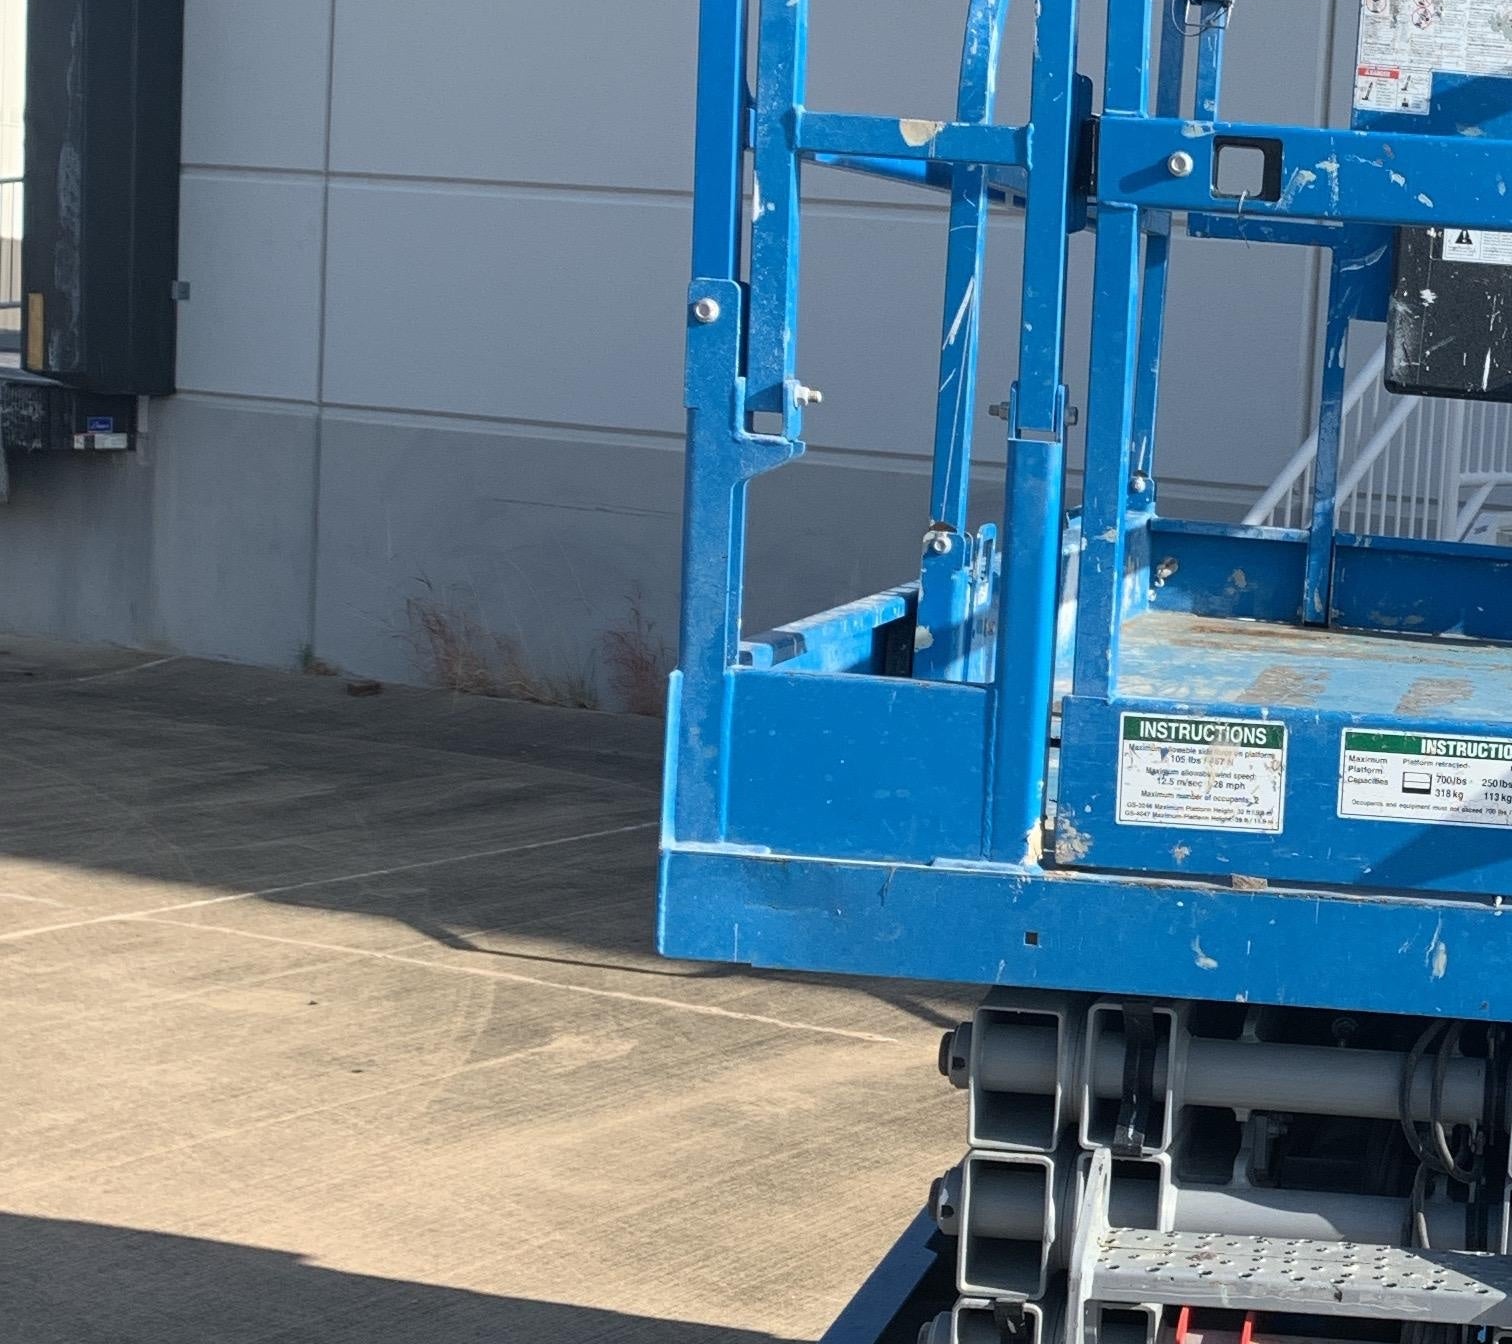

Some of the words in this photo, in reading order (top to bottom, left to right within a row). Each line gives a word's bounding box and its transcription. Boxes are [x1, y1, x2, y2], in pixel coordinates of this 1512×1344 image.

[1139, 721, 1267, 744] INSTRUCTIONS
[1171, 754, 1185, 763] 105
[1188, 755, 1201, 764] lbs
[1348, 755, 1388, 764] Maximum
[1402, 758, 1434, 767] Platform
[1348, 765, 1383, 774] Platform
[1157, 777, 1174, 786] 12.5
[1176, 778, 1203, 787] m/sec
[1214, 780, 1224, 789] 28
[1226, 781, 1245, 790] mph
[1347, 776, 1388, 786] Capacities
[1436, 774, 1452, 784] 700
[1482, 778, 1498, 788] 250
[1500, 779, 1512, 789] lbs
[1434, 789, 1451, 798] 318
[1453, 790, 1464, 801] kg
[1484, 792, 1499, 802] 113
[1501, 793, 1512, 804] kg
